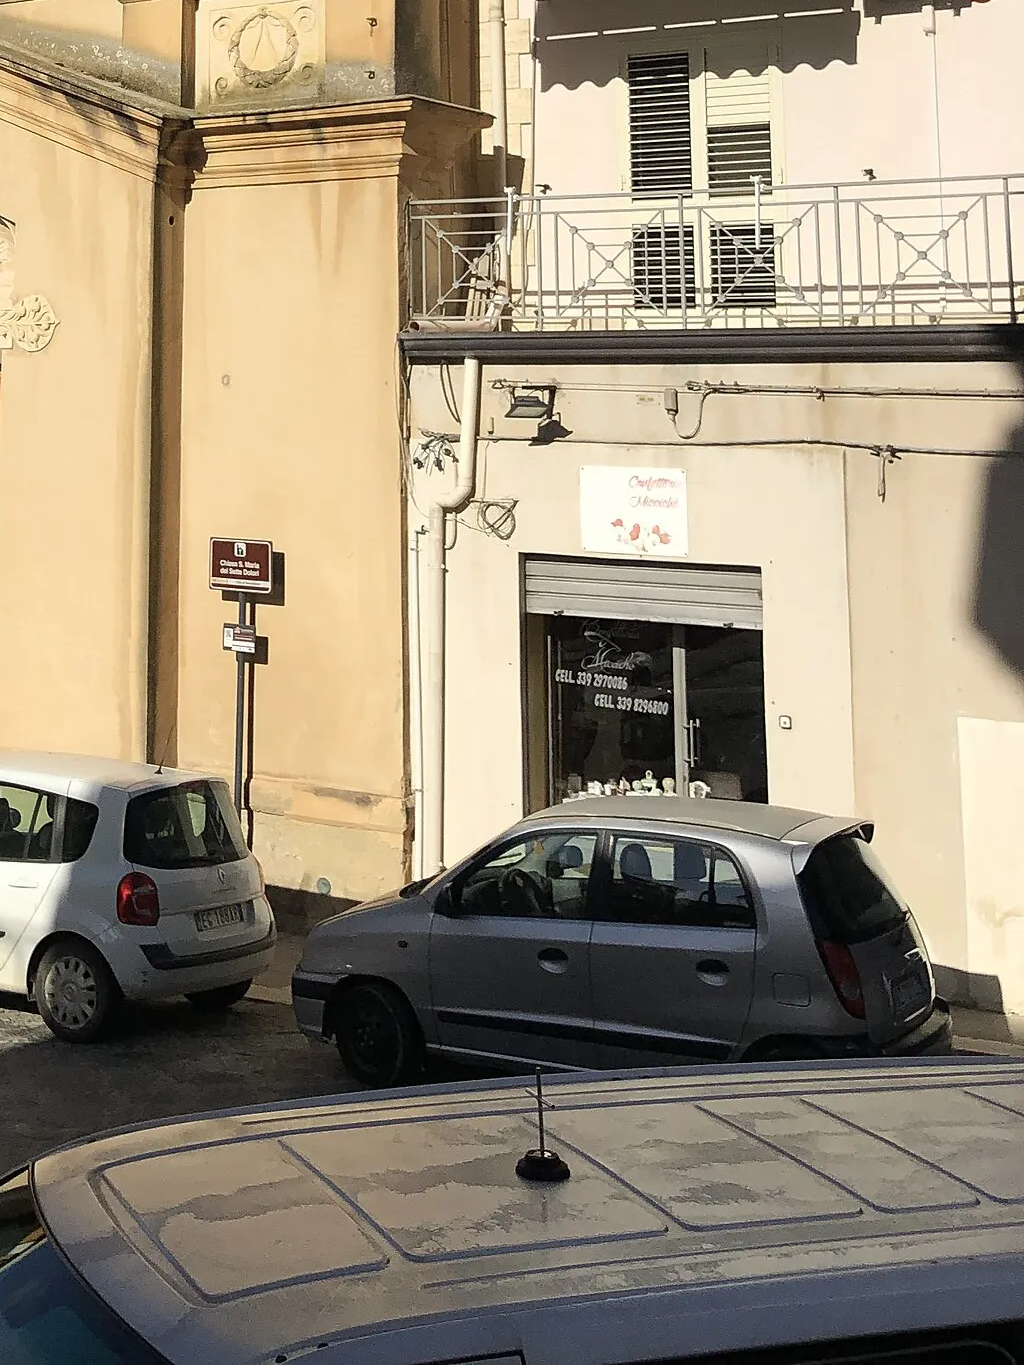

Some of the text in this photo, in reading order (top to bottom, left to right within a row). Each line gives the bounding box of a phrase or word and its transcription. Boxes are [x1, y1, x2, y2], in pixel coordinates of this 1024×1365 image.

[219, 559, 238, 567] Chiesa
[244, 561, 260, 569] Maria
[243, 569, 260, 577] Dolori
[555, 668, 575, 684] CELL.
[576, 671, 592, 687] 339
[594, 693, 669, 716] CELL. 339 8296800
